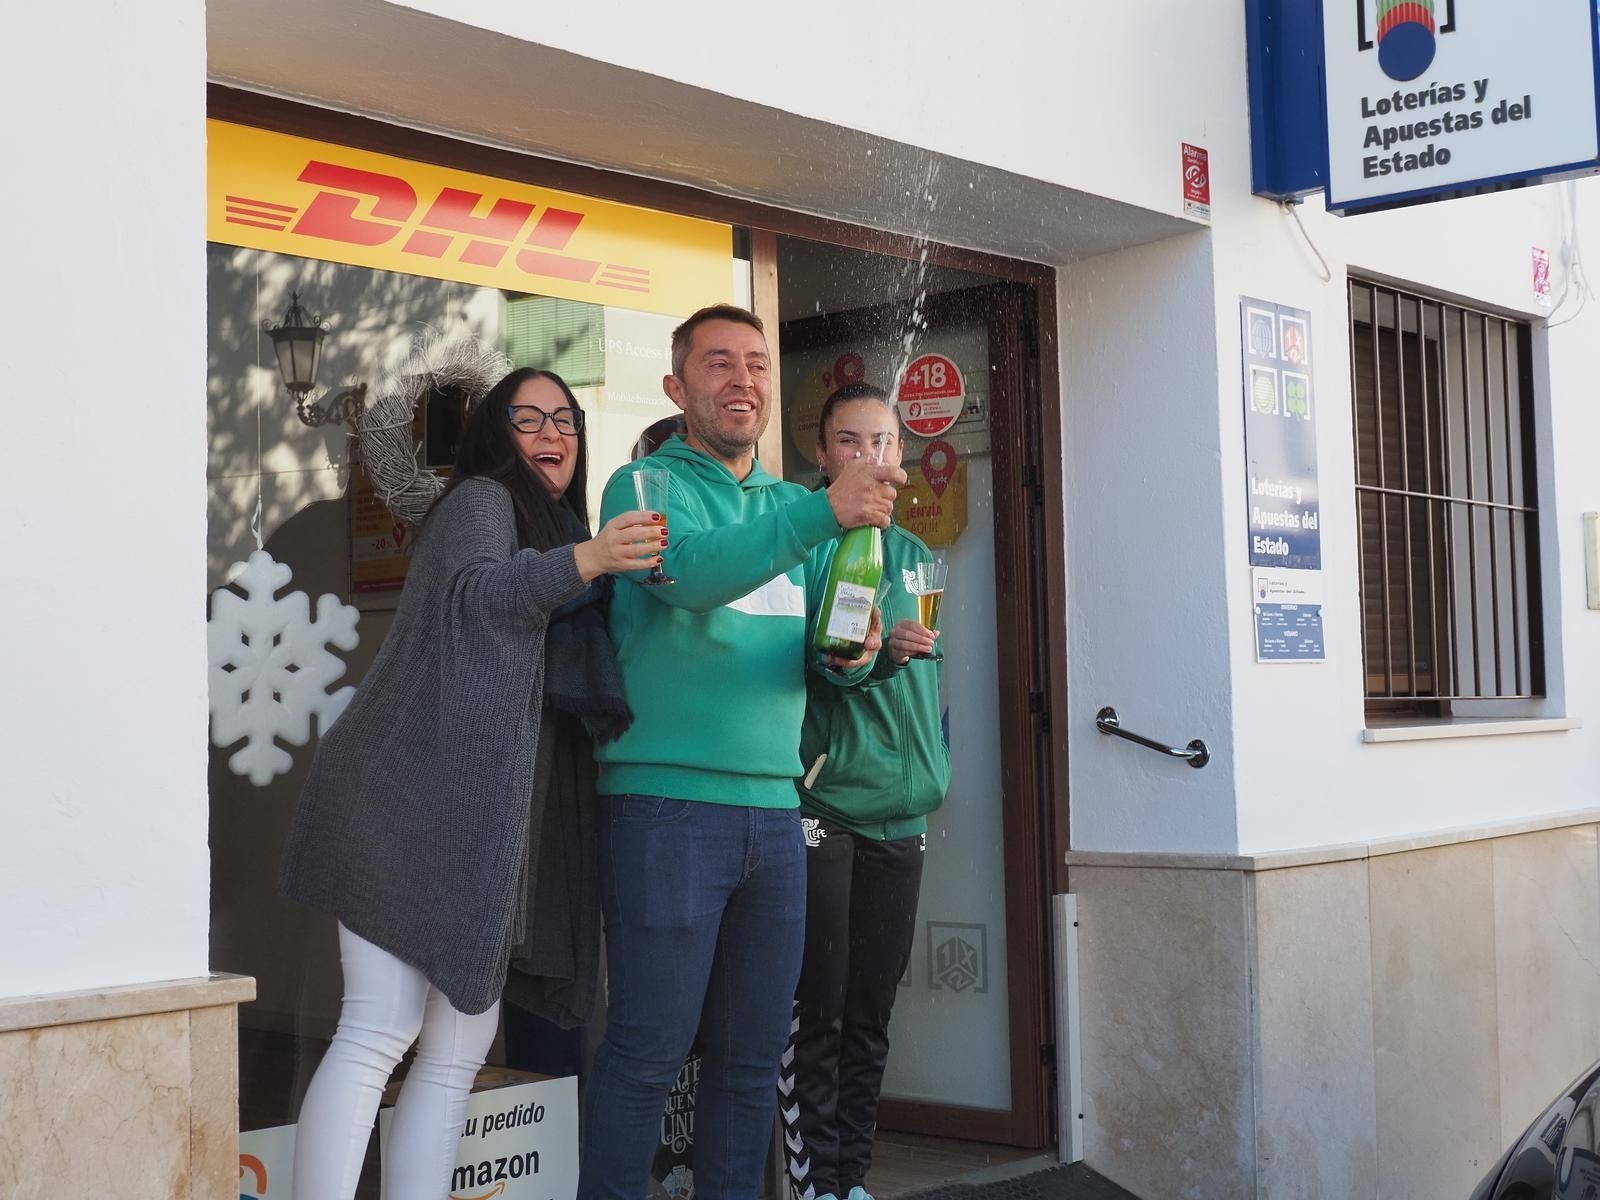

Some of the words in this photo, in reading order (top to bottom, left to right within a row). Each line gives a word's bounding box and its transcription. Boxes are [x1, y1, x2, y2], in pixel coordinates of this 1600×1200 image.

[1361, 82, 1466, 118] Loterías
[1474, 78, 1489, 103] y
[1363, 110, 1483, 150] Apuestas
[1491, 95, 1532, 124] del
[1363, 144, 1452, 179] Estado
[291, 159, 602, 283] DHL
[908, 362, 947, 389] +18
[1253, 507, 1300, 530] Apuestas
[1302, 511, 1318, 530] del
[1253, 536, 1290, 556] Estado
[809, 828, 828, 841] LEPE
[461, 1117, 477, 1138] u
[482, 1102, 546, 1138] pedido
[451, 1150, 540, 1192] mazon
